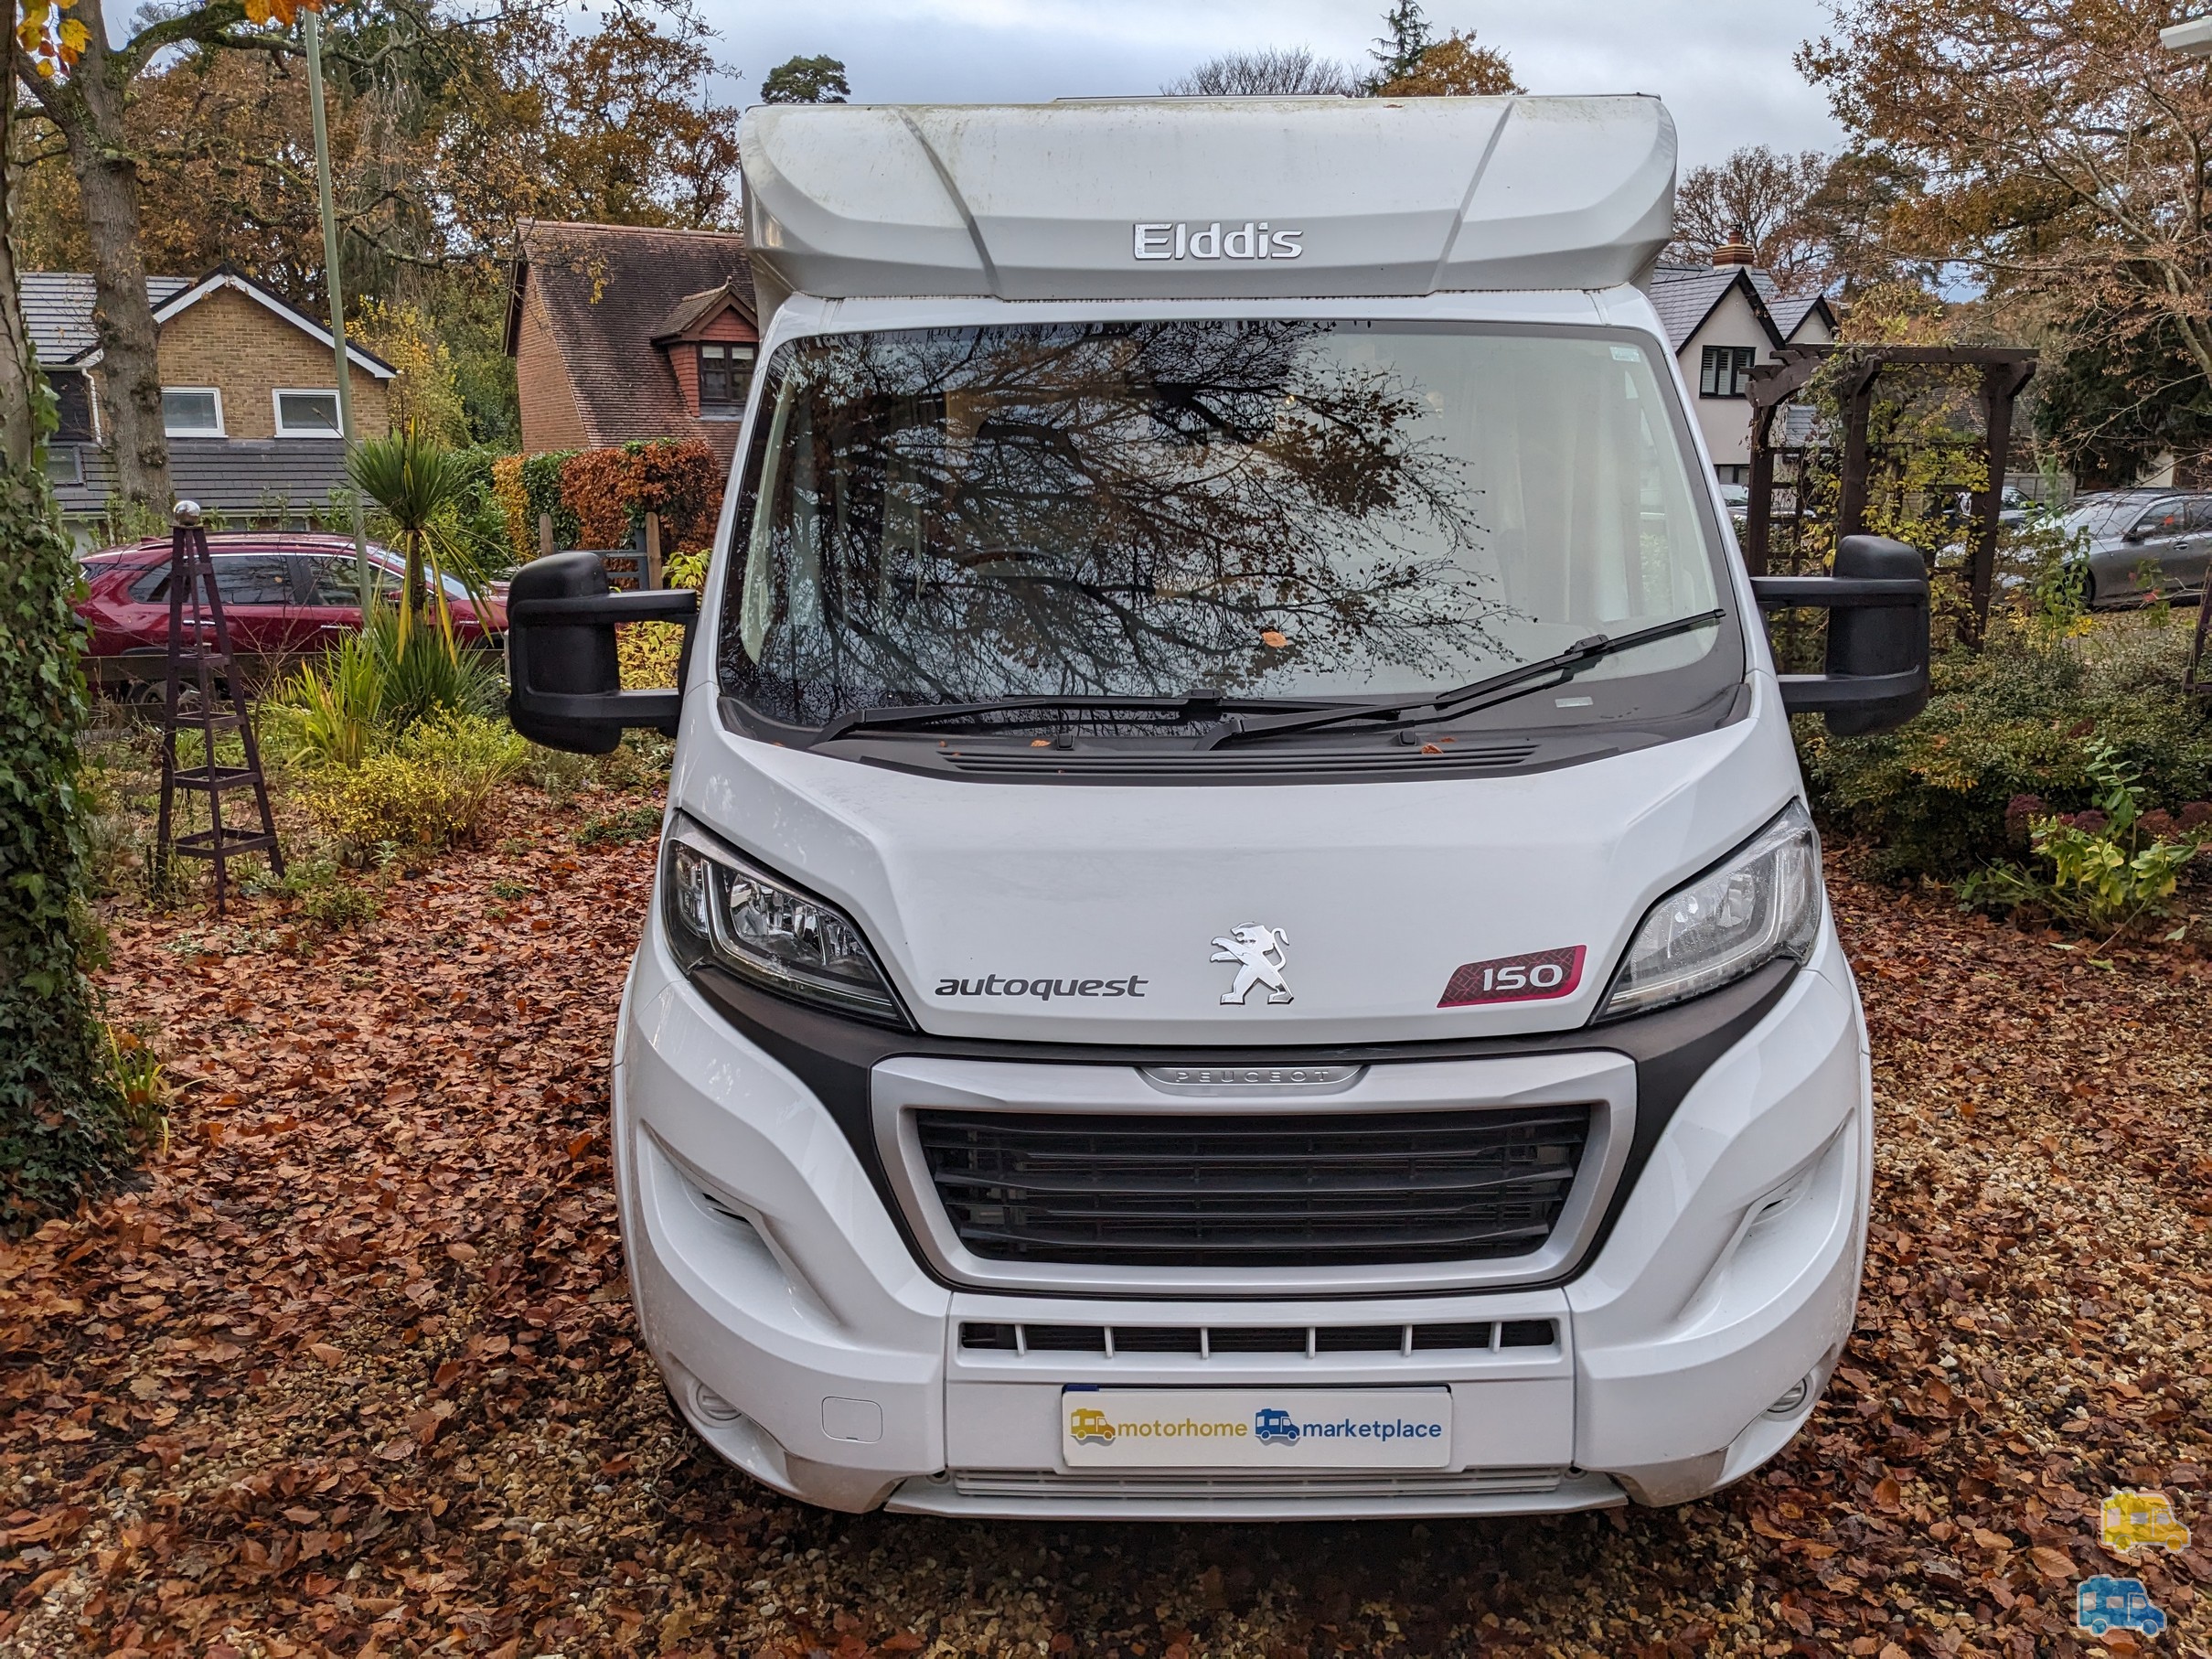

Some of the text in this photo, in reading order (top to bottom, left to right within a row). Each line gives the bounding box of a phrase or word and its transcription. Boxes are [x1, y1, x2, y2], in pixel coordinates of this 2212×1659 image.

[1133, 222, 1304, 260] Elddis
[935, 974, 1149, 1001] autoquest
[1175, 1071, 1329, 1082] PEUGEOT
[1117, 1418, 1441, 1441] motorhome marketplace
